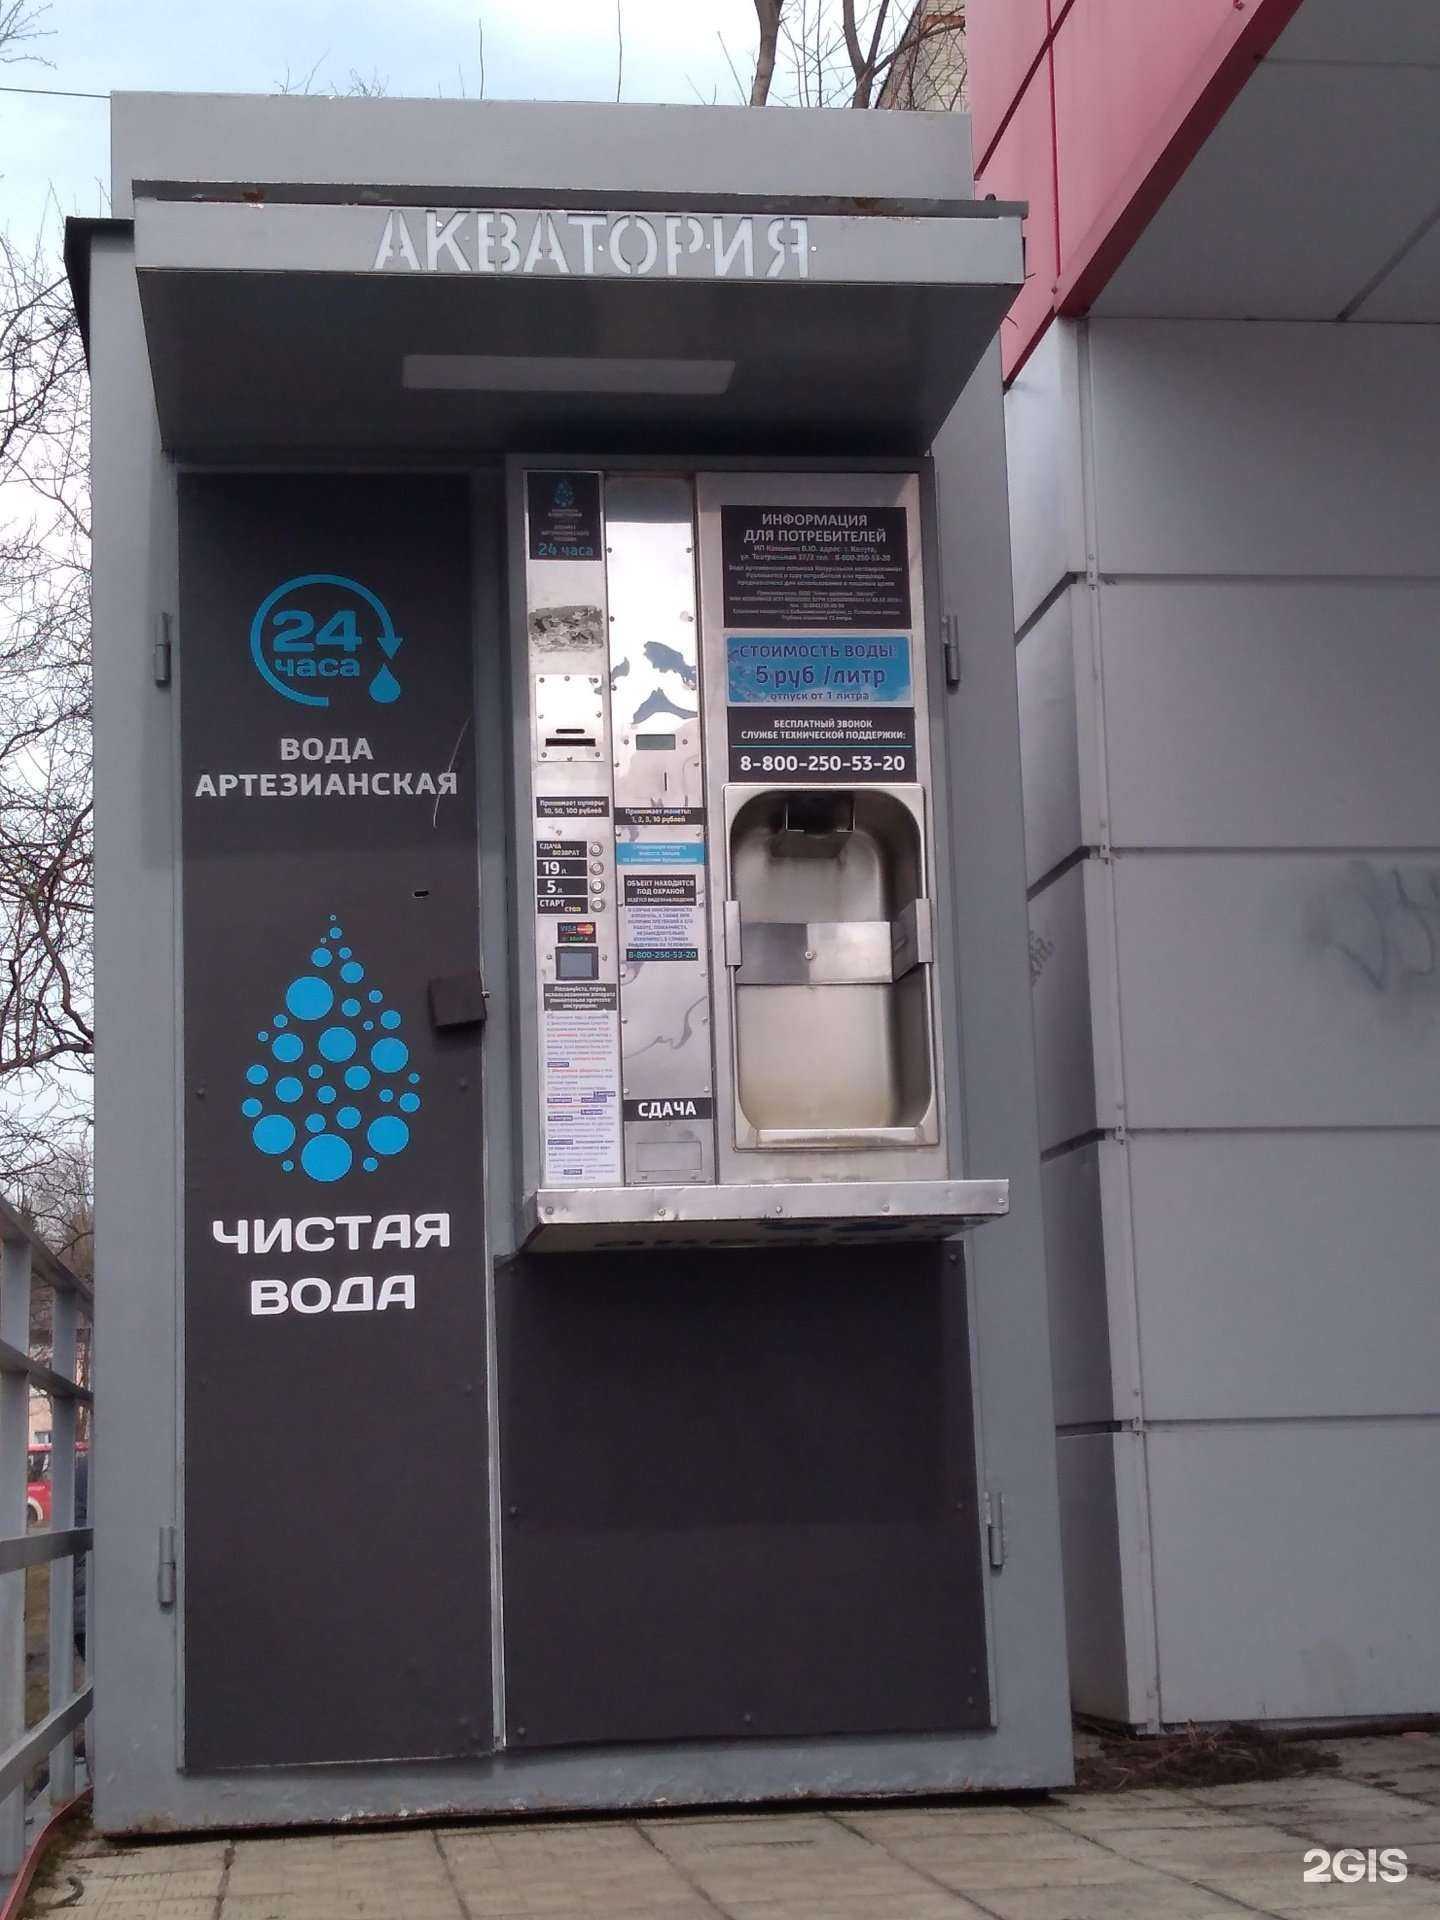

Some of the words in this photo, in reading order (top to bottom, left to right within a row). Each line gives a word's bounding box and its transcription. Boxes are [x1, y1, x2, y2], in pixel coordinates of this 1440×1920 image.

[373, 209, 809, 279] АКВАТОРИЯ
[762, 513, 868, 527] ИНФОРМАЦИЯ
[744, 530, 774, 544] ДЛЯ
[778, 528, 887, 543] ПОТРЕБИТЕЛЕЙ
[272, 609, 363, 653] 24
[739, 645, 840, 658] СТОИМОСТЬ
[273, 657, 361, 677] часа
[755, 665, 769, 684] 5
[775, 665, 815, 689] руб
[774, 718, 835, 728] БЕСПЛАТНЫЙ
[837, 719, 873, 728] ЗВОНОК
[741, 730, 778, 739] СЛУЖБЕ
[780, 729, 845, 740] ТЕХНИЧЕСКОЙ
[280, 737, 374, 764] ВОДА
[740, 755, 906, 772] 8-800-250-53-20
[195, 772, 458, 797] АРТЕЗИАНСКАЯ
[543, 861, 560, 875] 19
[547, 880, 557, 894] 5
[637, 888, 652, 896] ПОД
[653, 887, 685, 895] ОХРАНОЙ
[539, 899, 565, 907] СТАРТ
[638, 1101, 697, 1119] СДАЧА
[212, 1213, 451, 1254] ЧИСТАЯ
[250, 1275, 416, 1315] ВОДА
